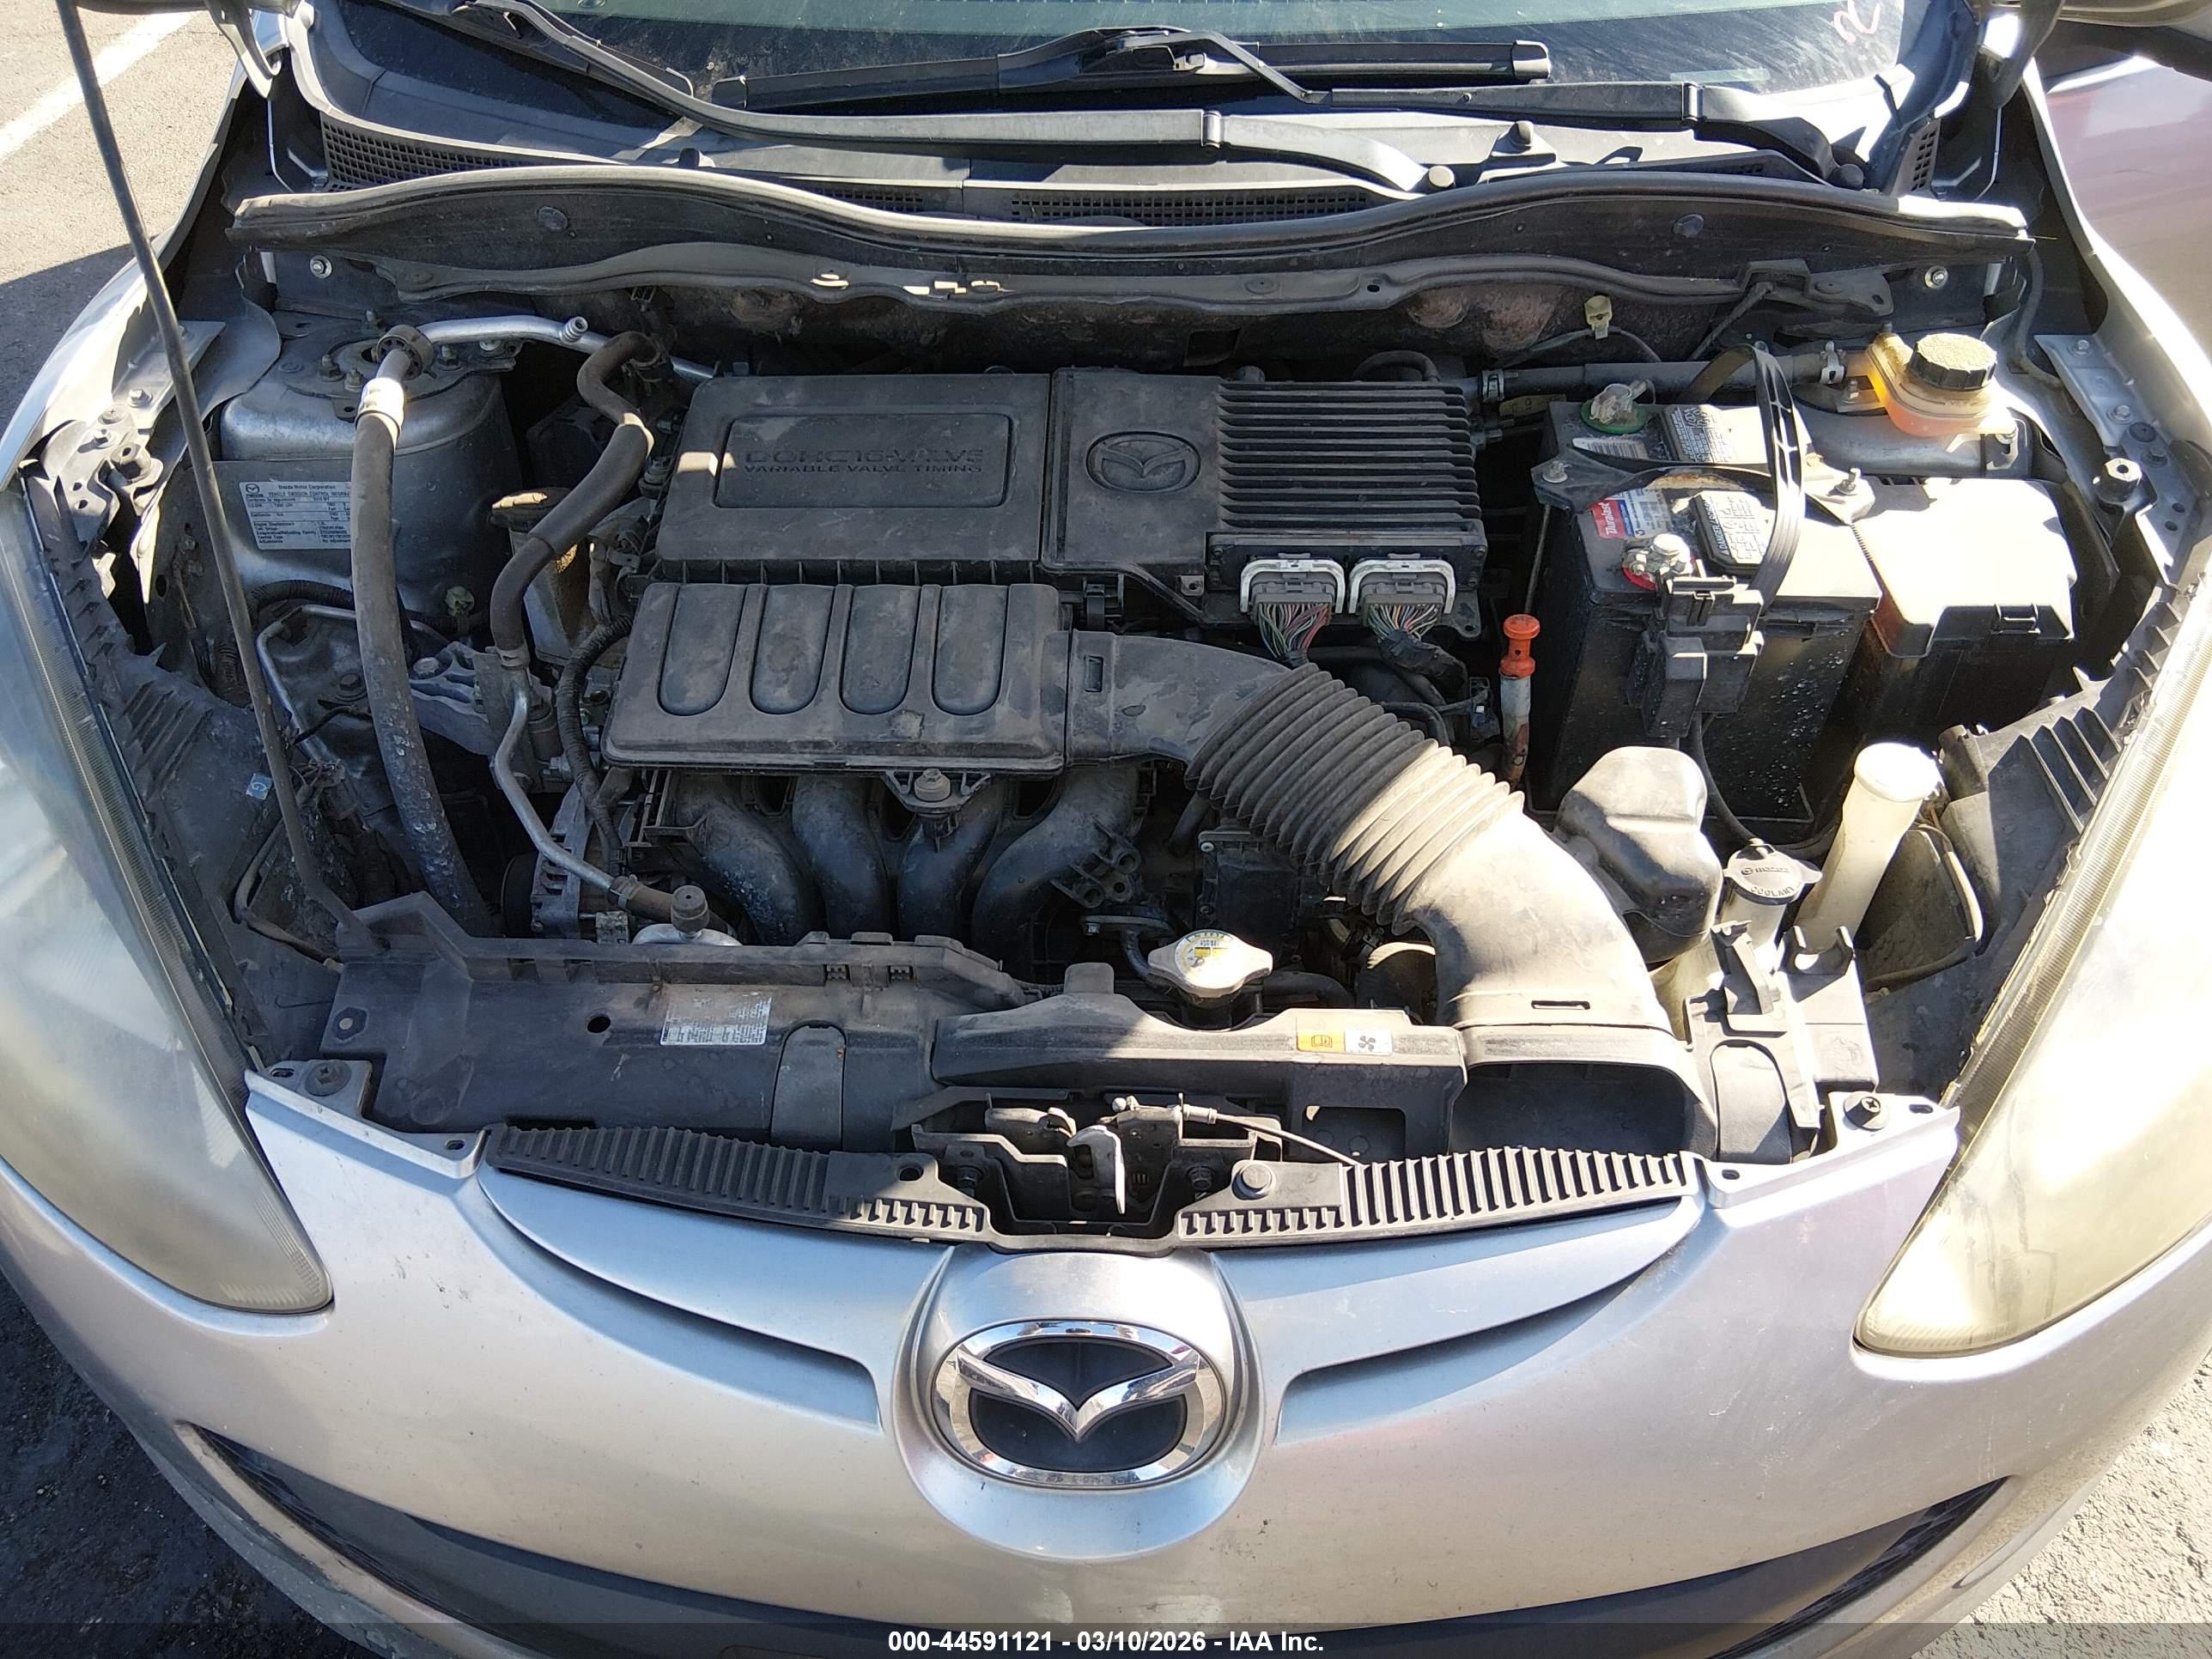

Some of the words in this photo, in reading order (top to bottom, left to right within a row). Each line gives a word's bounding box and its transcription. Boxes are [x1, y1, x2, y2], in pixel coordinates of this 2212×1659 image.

[744, 449, 850, 463] DOHC
[744, 465, 840, 473] VARIABLE
[847, 465, 908, 473] VALVE
[913, 465, 983, 473] TIMING
[1601, 501, 1618, 536] Duralast
[1711, 524, 1729, 550] DANGER
[1751, 885, 1796, 896] COOLANT
